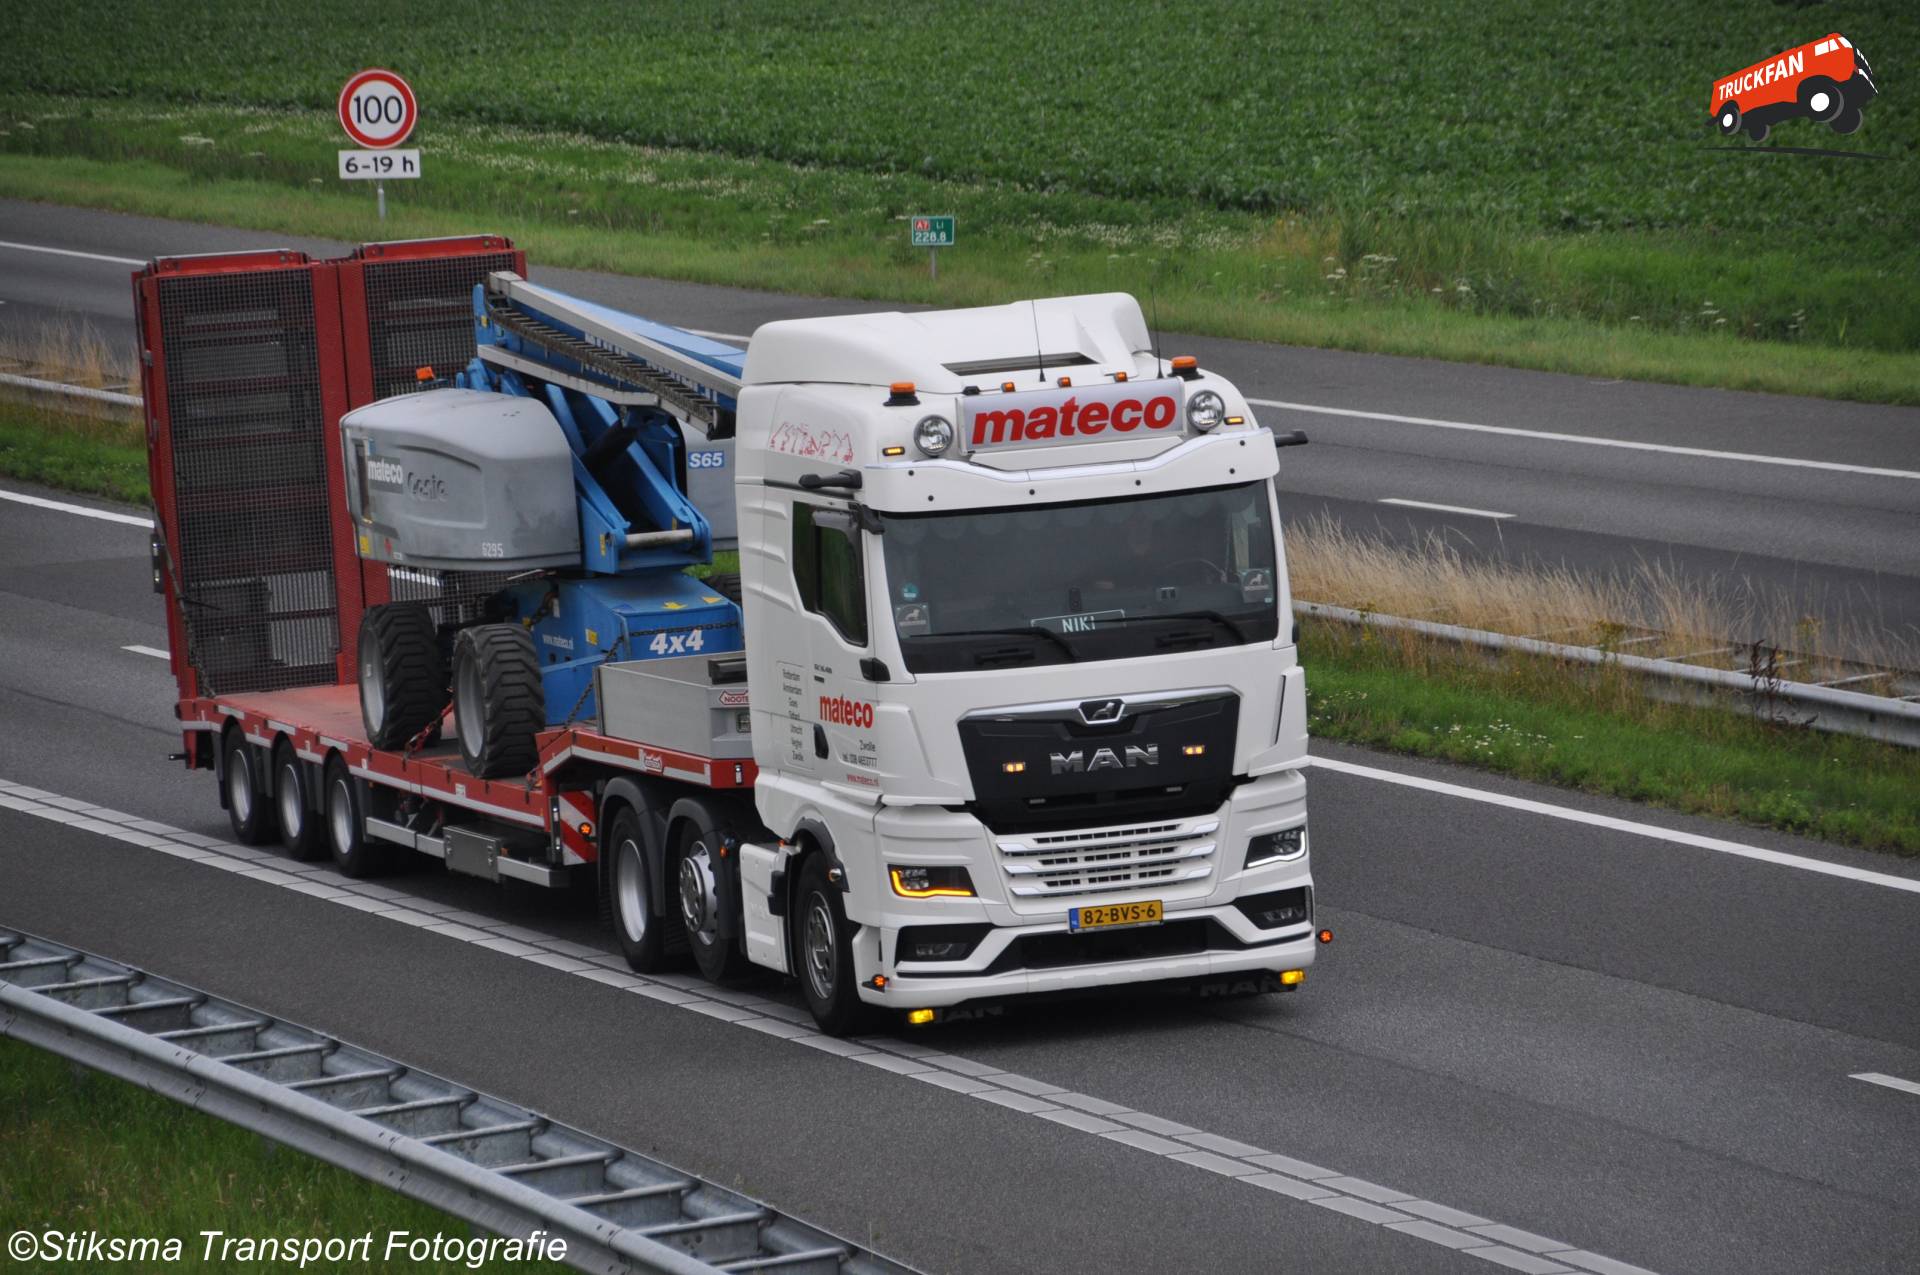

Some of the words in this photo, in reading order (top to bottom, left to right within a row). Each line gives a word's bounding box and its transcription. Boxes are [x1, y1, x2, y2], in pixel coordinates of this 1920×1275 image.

[353, 95, 403, 124] 100
[345, 156, 393, 173] 6-19
[402, 156, 414, 173] h
[972, 396, 1177, 445] mateco
[367, 457, 404, 485] mateco
[689, 452, 723, 468] S65
[1062, 615, 1096, 633] NIKI
[649, 628, 704, 655] 4x4
[819, 694, 874, 729] mateco
[1049, 743, 1160, 775] MAN
[1083, 904, 1157, 925] 82-BVS-6
